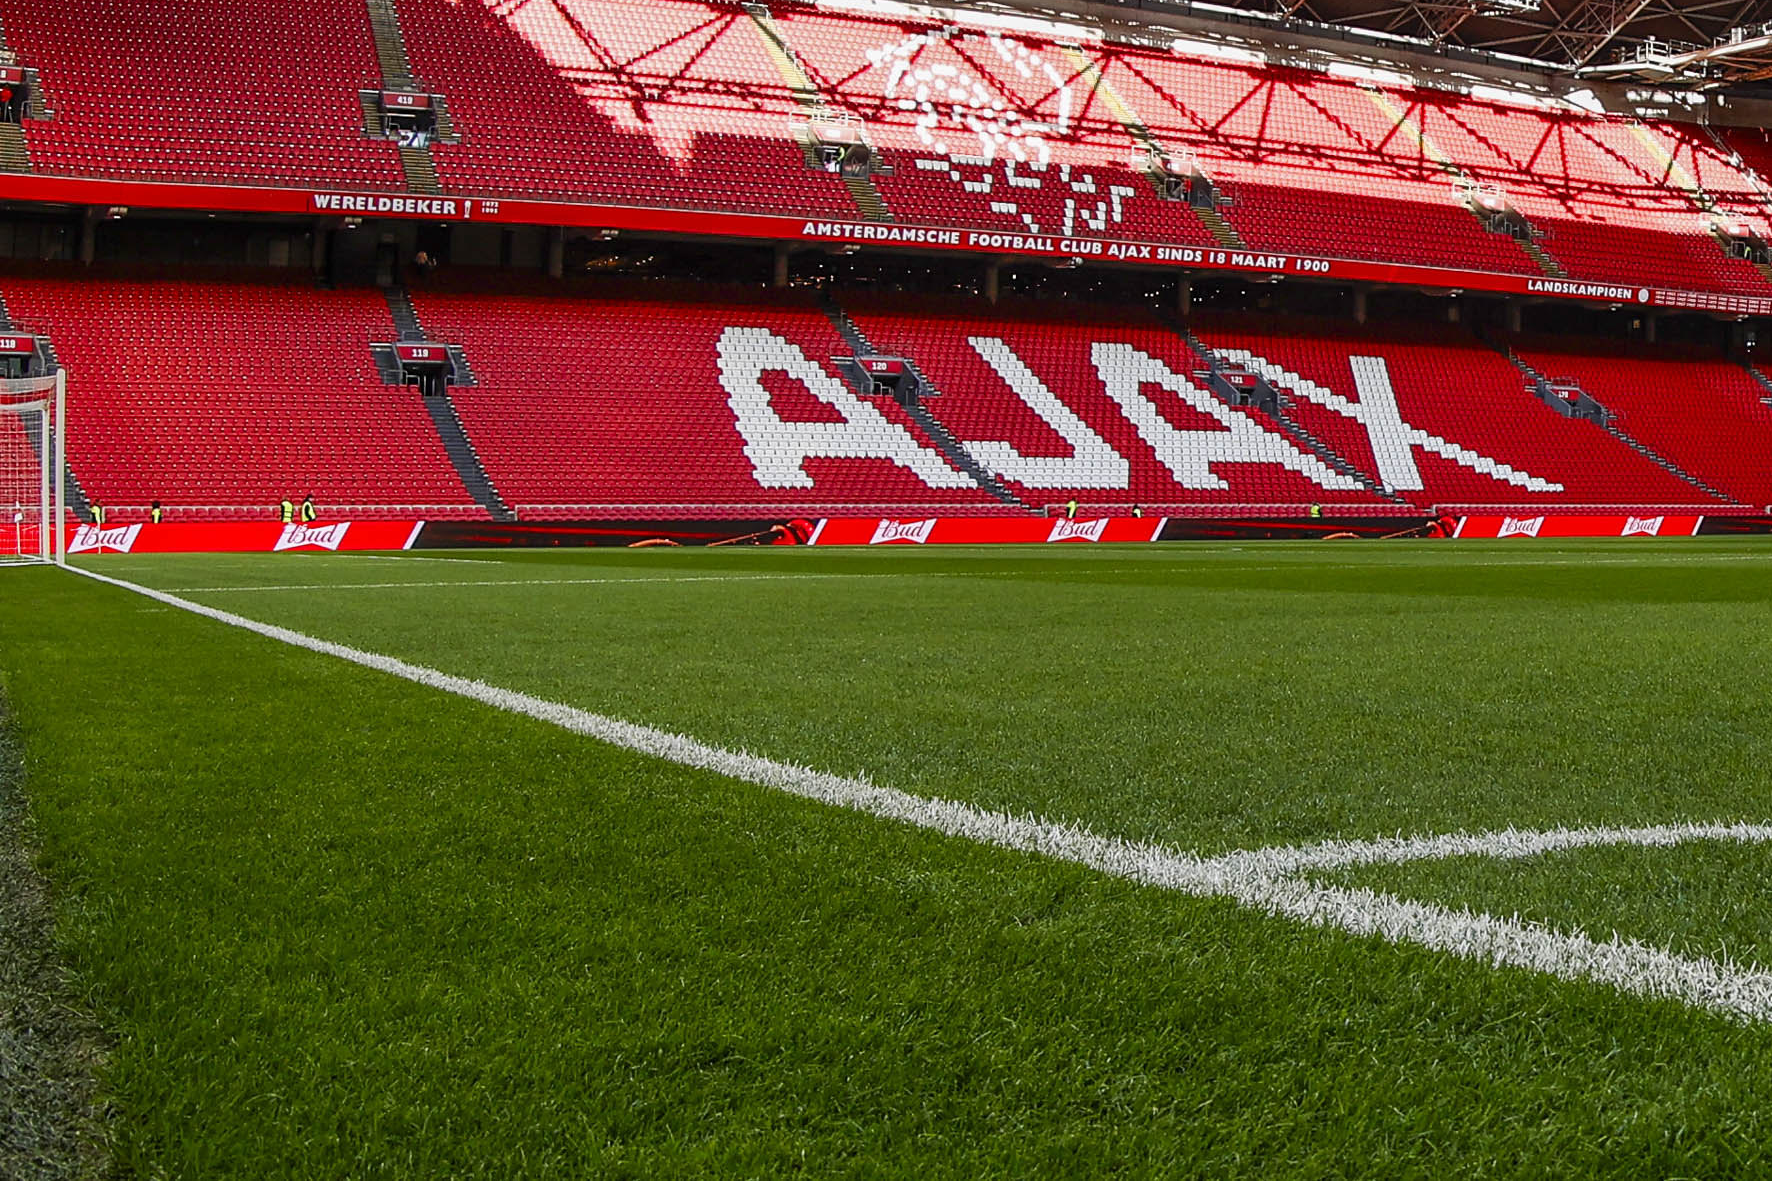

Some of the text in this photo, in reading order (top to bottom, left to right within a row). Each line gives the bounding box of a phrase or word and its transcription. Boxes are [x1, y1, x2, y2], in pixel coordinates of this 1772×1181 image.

[314, 194, 456, 214] WERELDBEKER
[802, 222, 1330, 272] AMSTERDAMSCHE FOOTBALL CLUB AJAX SINDS 18 MAART 1900
[1527, 280, 1633, 299] LANDSKAMPIOEN
[872, 362, 887, 370] 120
[1230, 375, 1243, 384] 121
[717, 327, 1563, 492] AJAX
[286, 523, 336, 543] Bud
[881, 519, 925, 538] Bud
[1057, 519, 1098, 536] Bud
[1505, 518, 1536, 532] Bud
[1628, 518, 1656, 531] Bud
[80, 524, 129, 545] Bud
